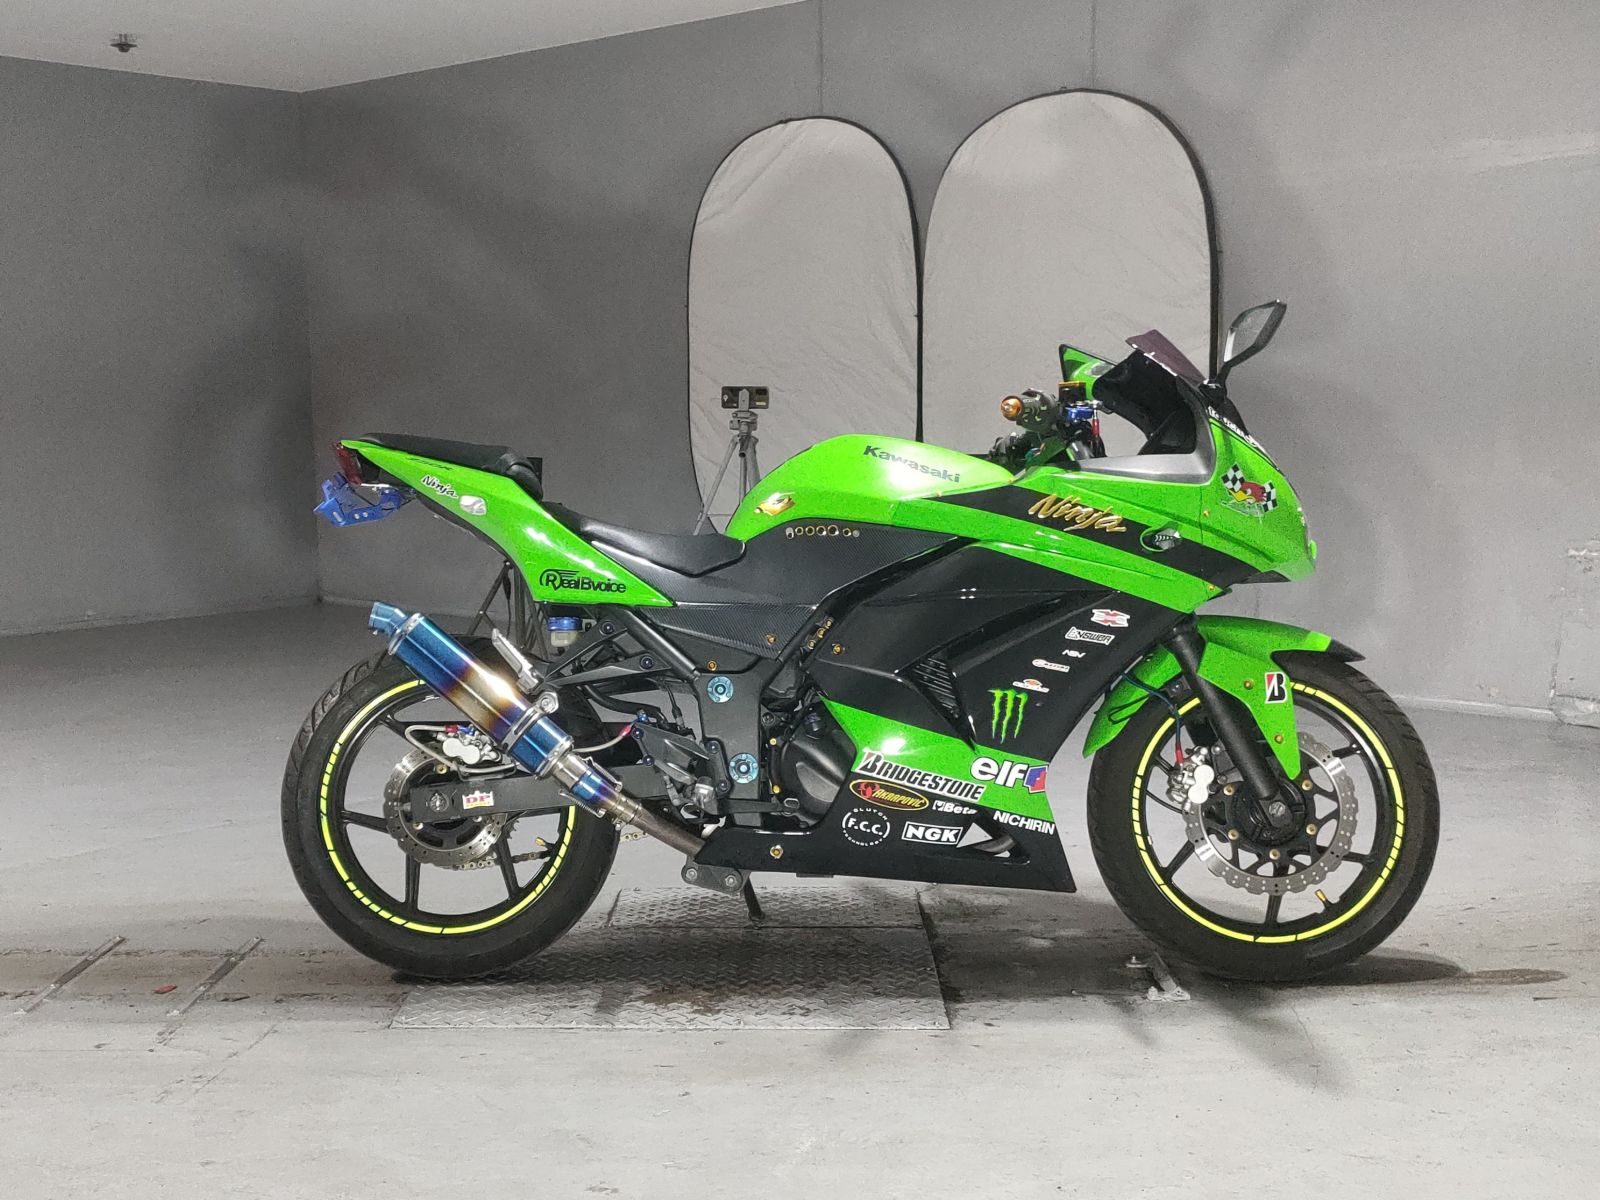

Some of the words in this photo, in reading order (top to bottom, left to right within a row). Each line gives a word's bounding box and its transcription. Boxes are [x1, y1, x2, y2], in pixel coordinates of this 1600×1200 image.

[863, 445, 961, 483] Kawasaki
[421, 474, 459, 499] Ninja
[1028, 493, 1127, 532] Ninja
[857, 752, 985, 801] BRIDGESTONE
[970, 756, 1029, 789] elf
[905, 825, 960, 842] NGK
[993, 810, 1055, 836] NICHIRIN
